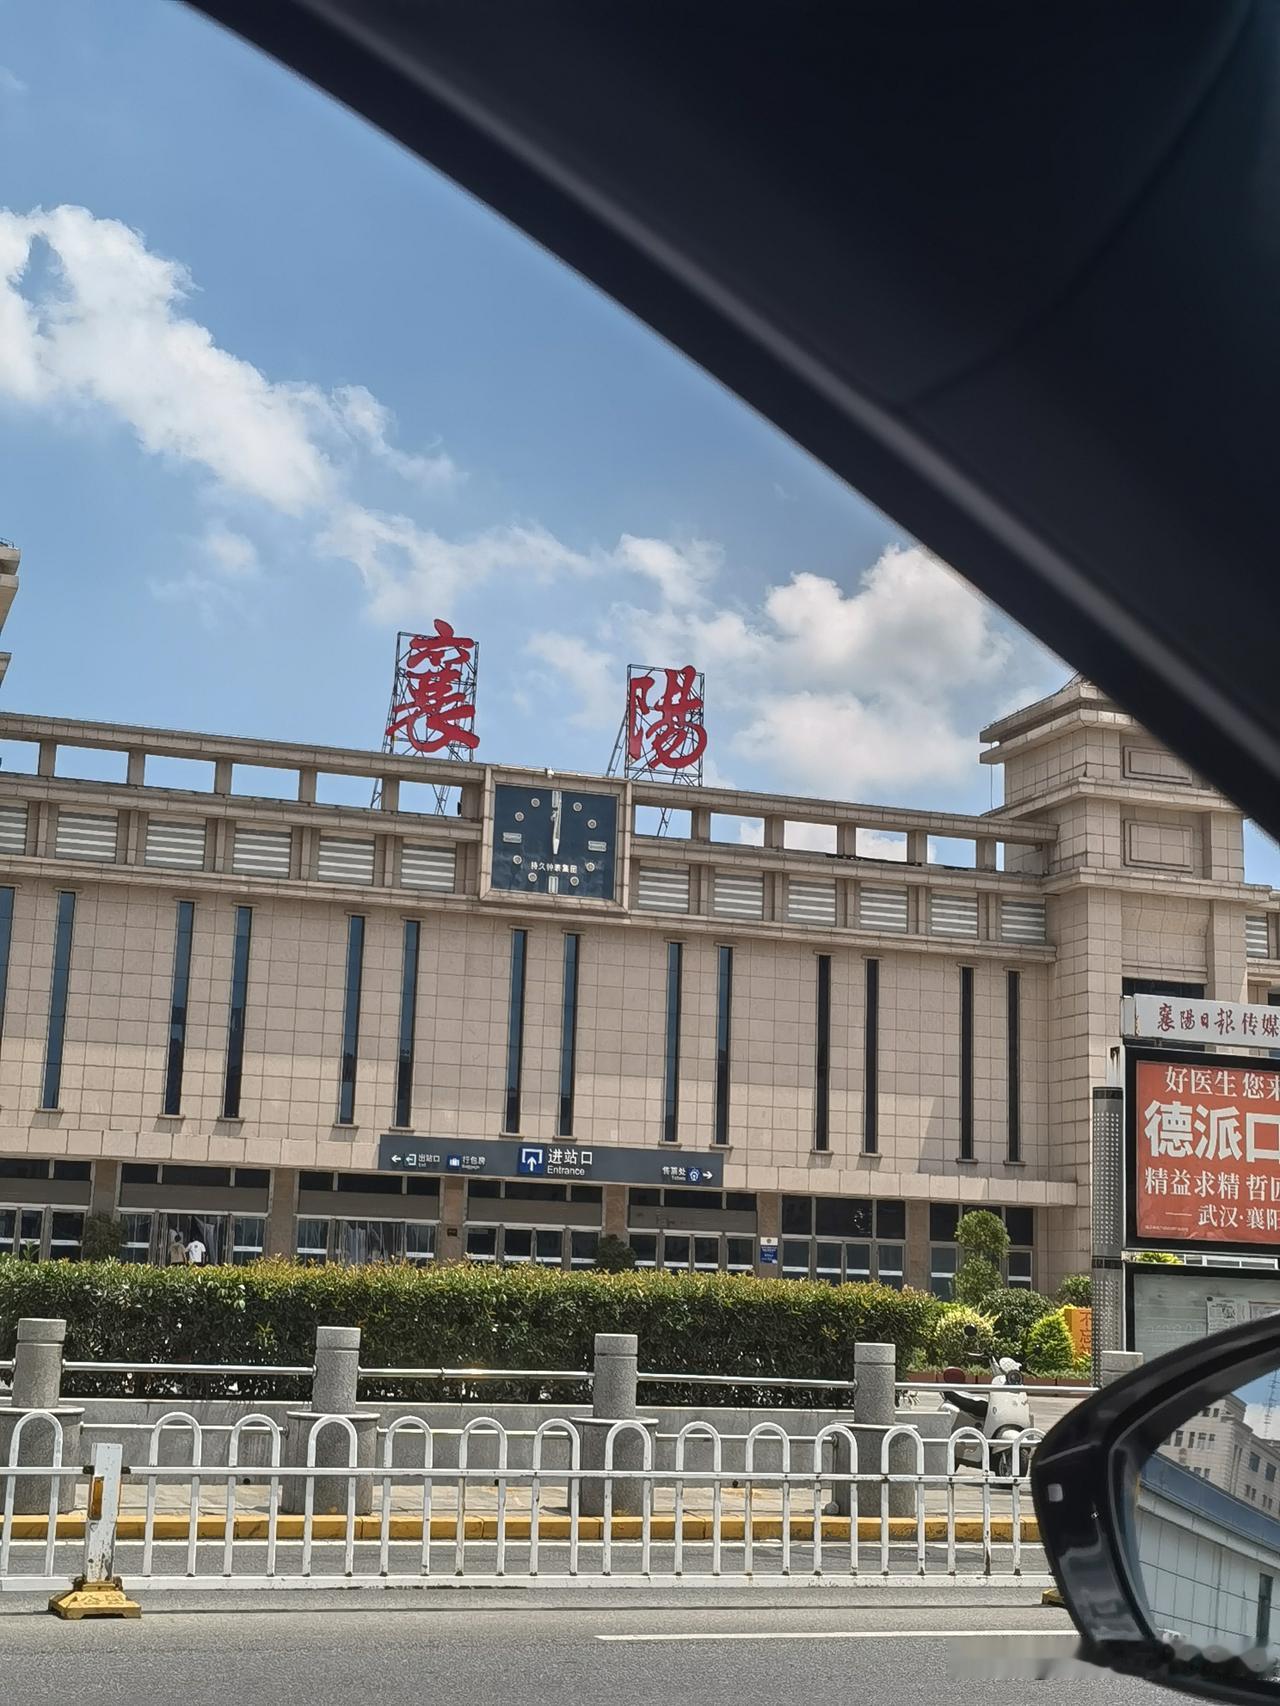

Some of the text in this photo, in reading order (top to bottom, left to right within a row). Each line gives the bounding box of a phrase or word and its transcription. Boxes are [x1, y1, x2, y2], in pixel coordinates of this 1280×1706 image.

[418, 1153, 440, 1163] 出站口
[547, 1148, 593, 1165] 进站口
[547, 1165, 585, 1176] Entrance
